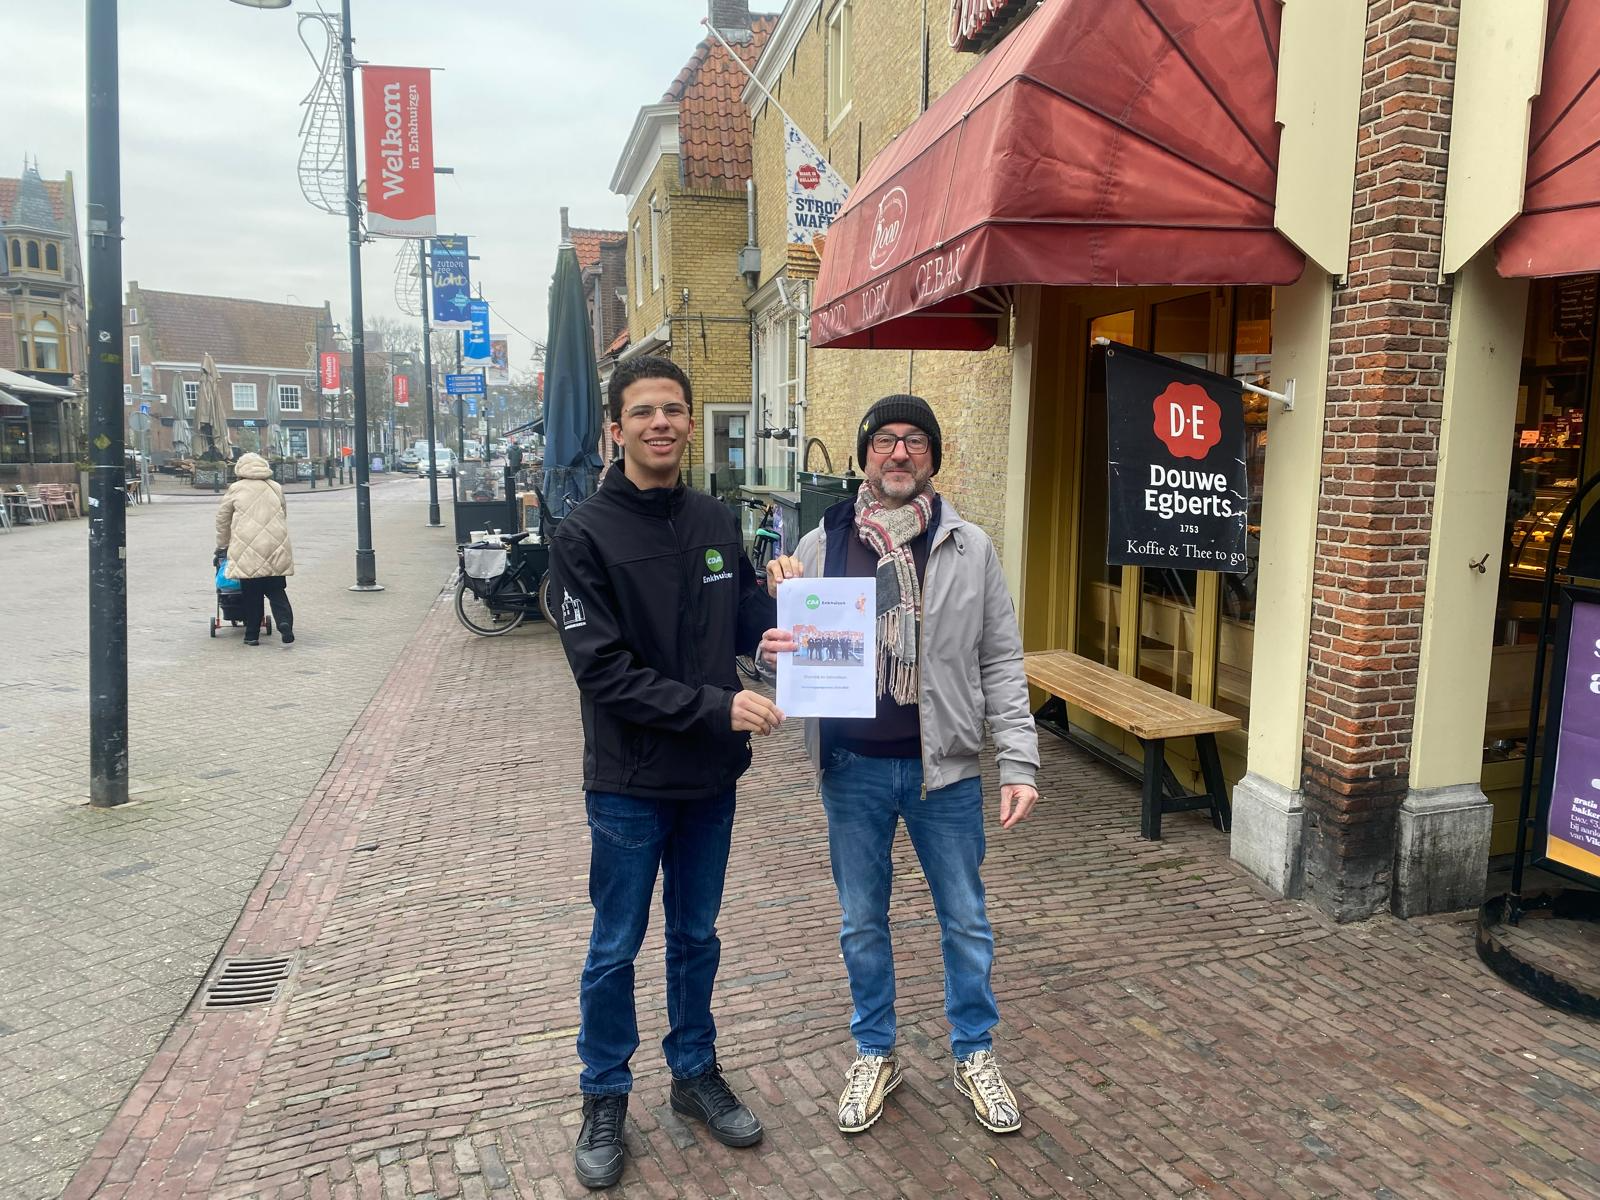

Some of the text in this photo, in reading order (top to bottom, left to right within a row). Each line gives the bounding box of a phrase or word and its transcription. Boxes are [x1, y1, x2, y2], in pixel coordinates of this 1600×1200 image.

[406, 84, 420, 170] in Enkhuizen
[381, 82, 404, 200] Welkom
[861, 279, 890, 323] KOEK
[916, 244, 966, 299] GEBAK
[1149, 464, 1227, 492] Douwe
[1144, 489, 1232, 519] Egberts
[1179, 524, 1199, 533] 1753
[1126, 539, 1245, 565] Koffie & Thee to go
[1574, 798, 1598, 809] gratis
[1569, 831, 1584, 841] van
[1570, 821, 1580, 832] bij
